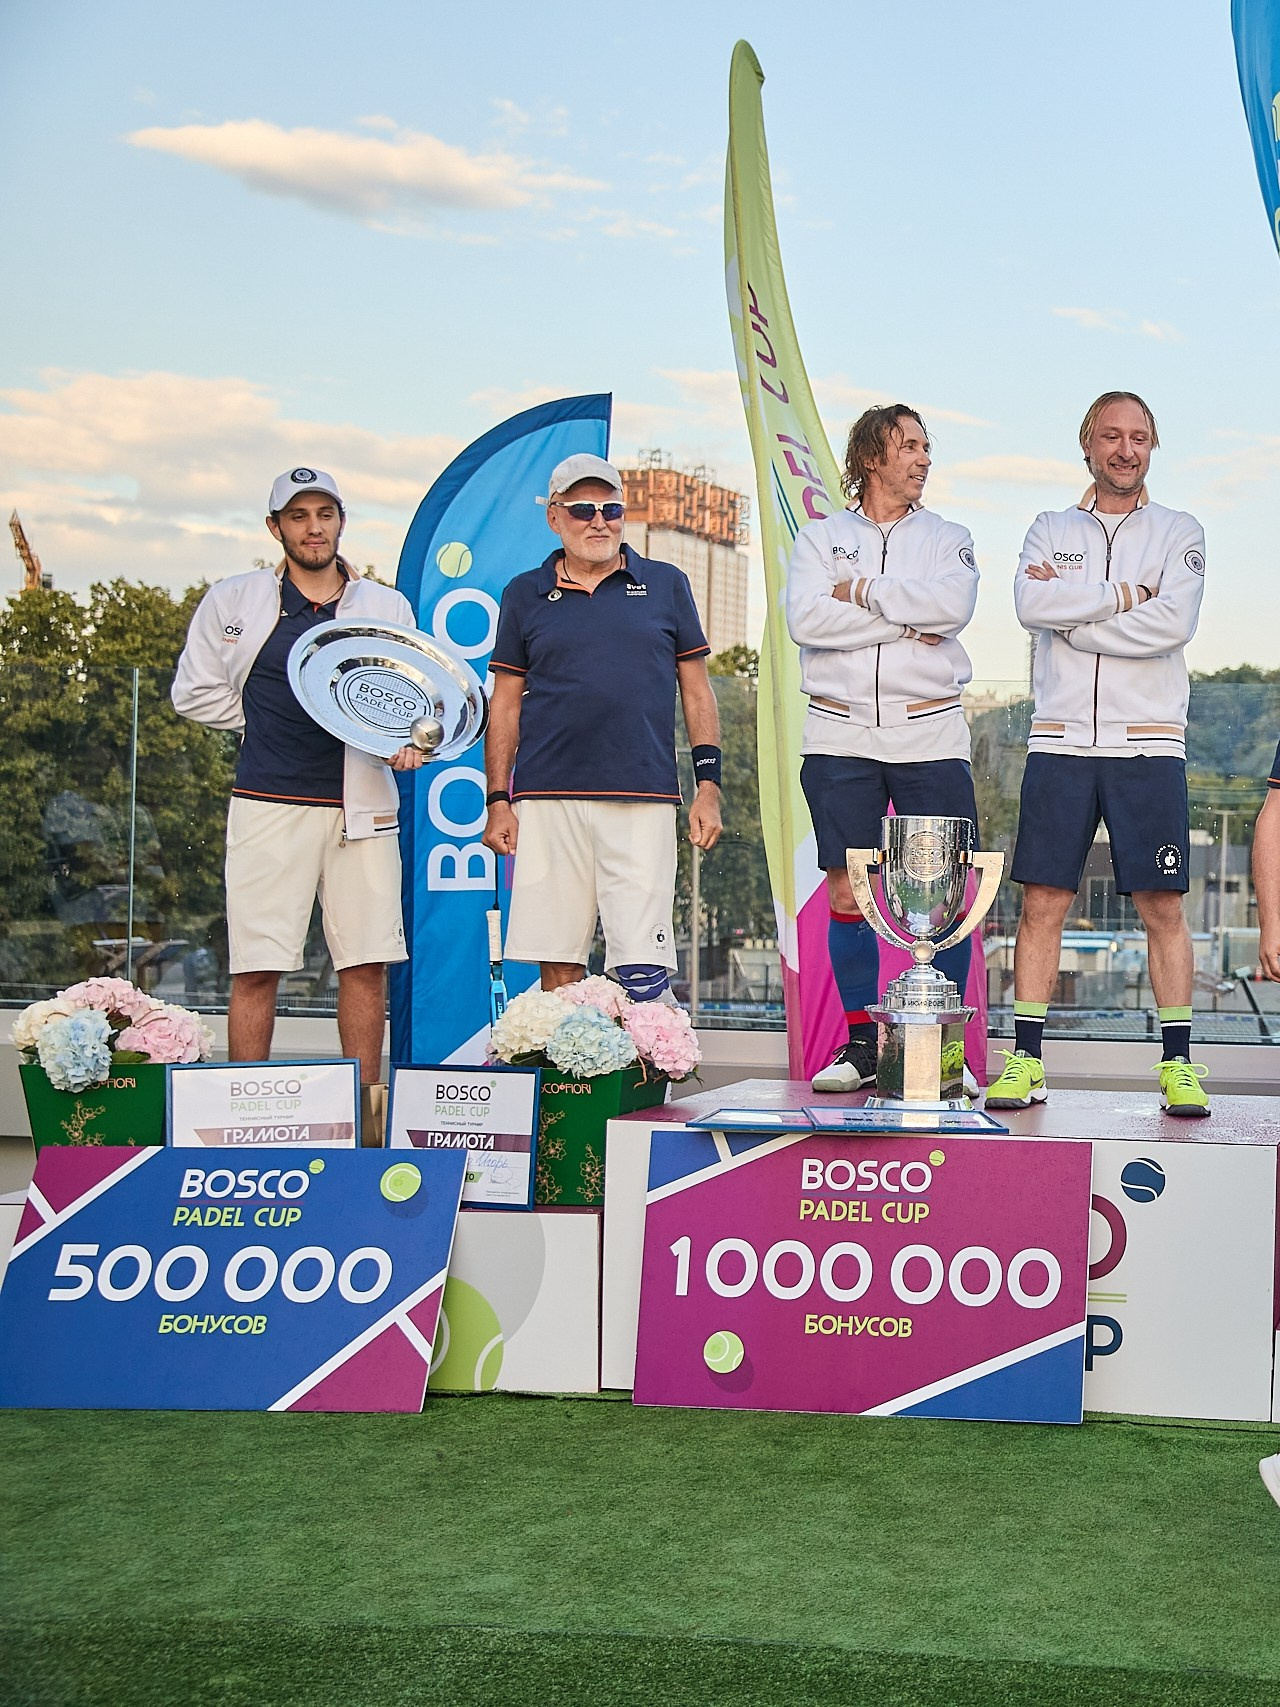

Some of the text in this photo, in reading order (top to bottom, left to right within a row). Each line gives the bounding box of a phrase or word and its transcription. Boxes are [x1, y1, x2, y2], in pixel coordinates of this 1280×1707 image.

[1053, 552, 1084, 562] OSCO
[355, 693, 414, 719] PADEL CUP
[359, 682, 417, 711] BOSCO
[107, 1078, 136, 1089] FIORI
[230, 1080, 302, 1097] BOSCO
[436, 1084, 491, 1101] BOSCO
[565, 1083, 592, 1095] FIORI
[230, 1099, 302, 1112] PADEL CUP
[434, 1105, 490, 1117] PADEL CUP
[223, 1125, 310, 1143] ГРАМОТА
[427, 1132, 495, 1150] ГРАМОТА
[179, 1168, 310, 1199] BOSCO
[801, 1158, 933, 1193] BOSCO
[172, 1207, 302, 1227] PADEL CUP
[800, 1199, 930, 1224] PADEL CUP
[47, 1243, 393, 1304] 500 000
[890, 1244, 1062, 1309] 000
[158, 1314, 267, 1335] БОНУСОВ
[804, 1314, 912, 1338] БОНУСОВ
